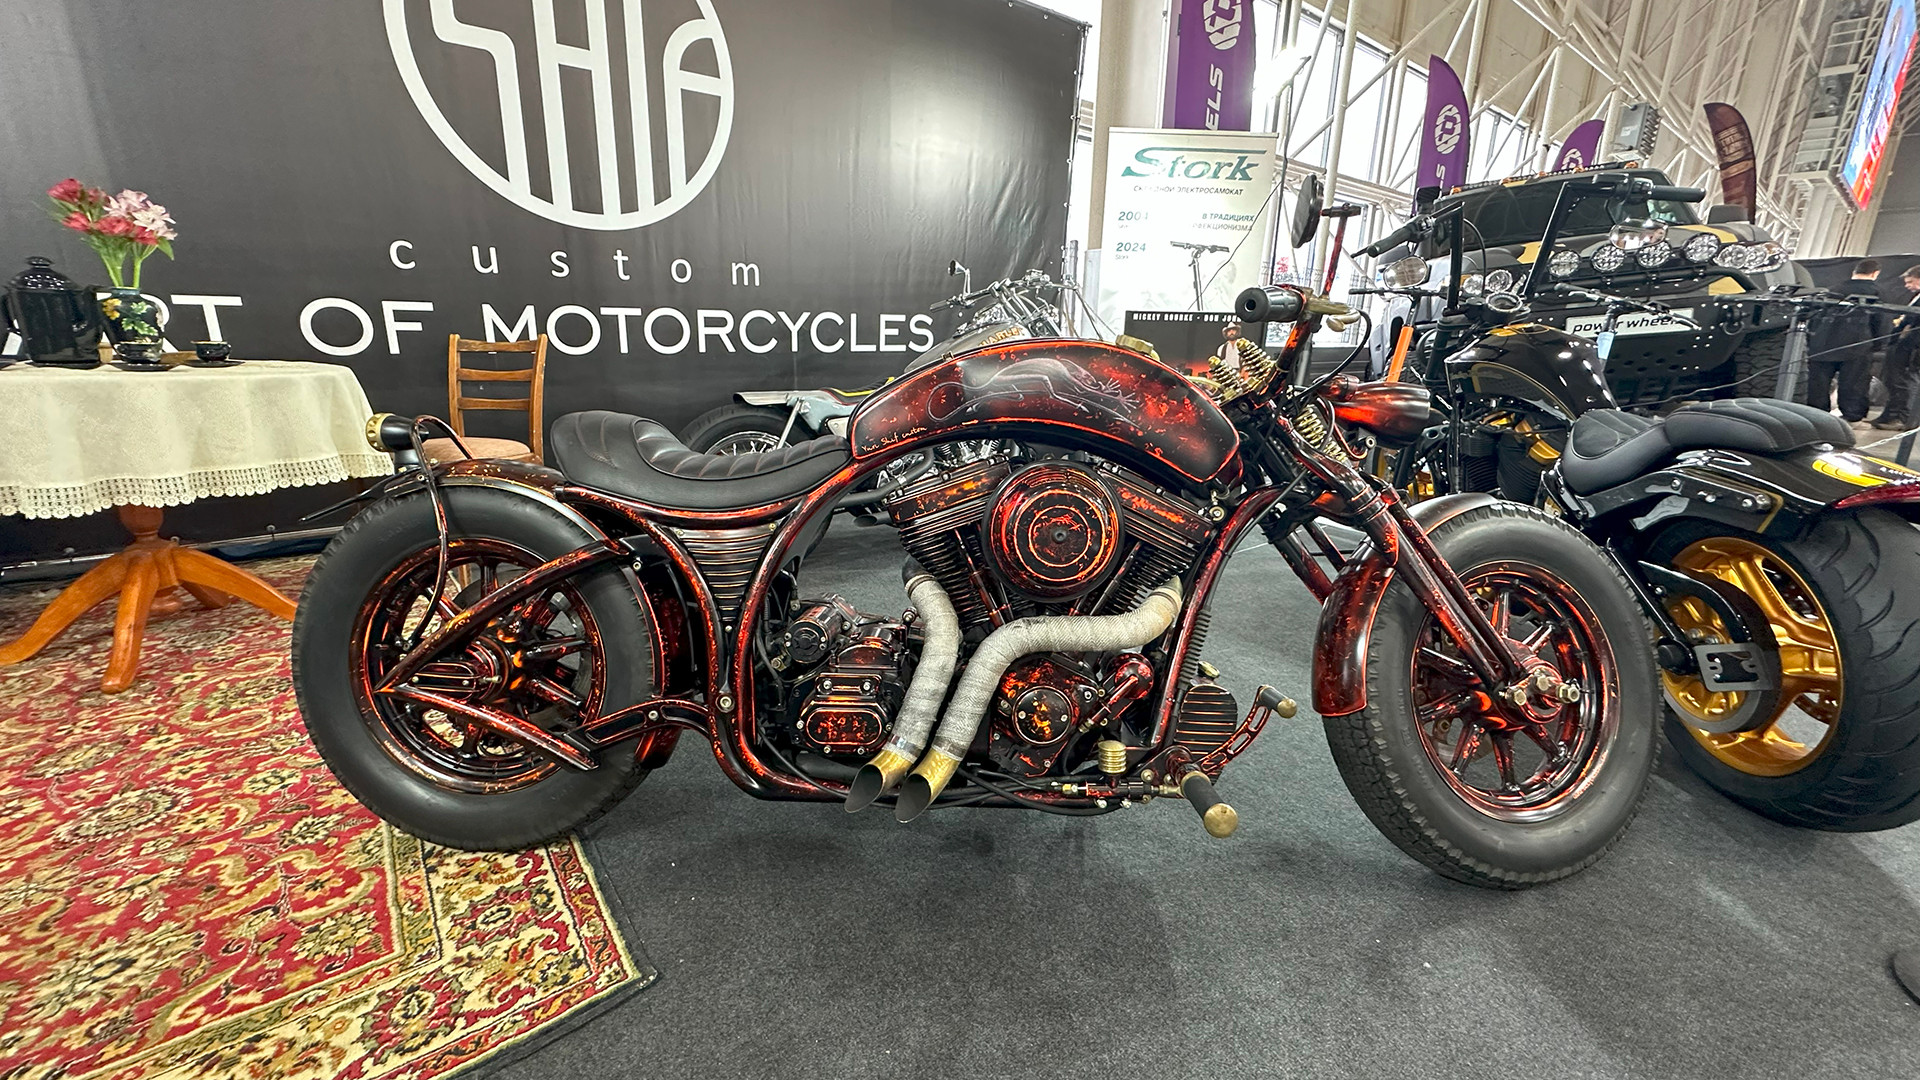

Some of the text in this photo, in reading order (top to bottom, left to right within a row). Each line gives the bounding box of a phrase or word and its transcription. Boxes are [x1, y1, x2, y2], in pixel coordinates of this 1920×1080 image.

[1121, 147, 1267, 181] Stork
[1210, 213, 1255, 222] ТРАДИЦИЯХ
[1116, 242, 1147, 252] 2024
[389, 239, 760, 287] custom
[1132, 313, 1161, 321] MICKEY
[300, 298, 434, 357] OF
[481, 302, 935, 356] MOTORCYCLES
[1573, 321, 1624, 335] powr
